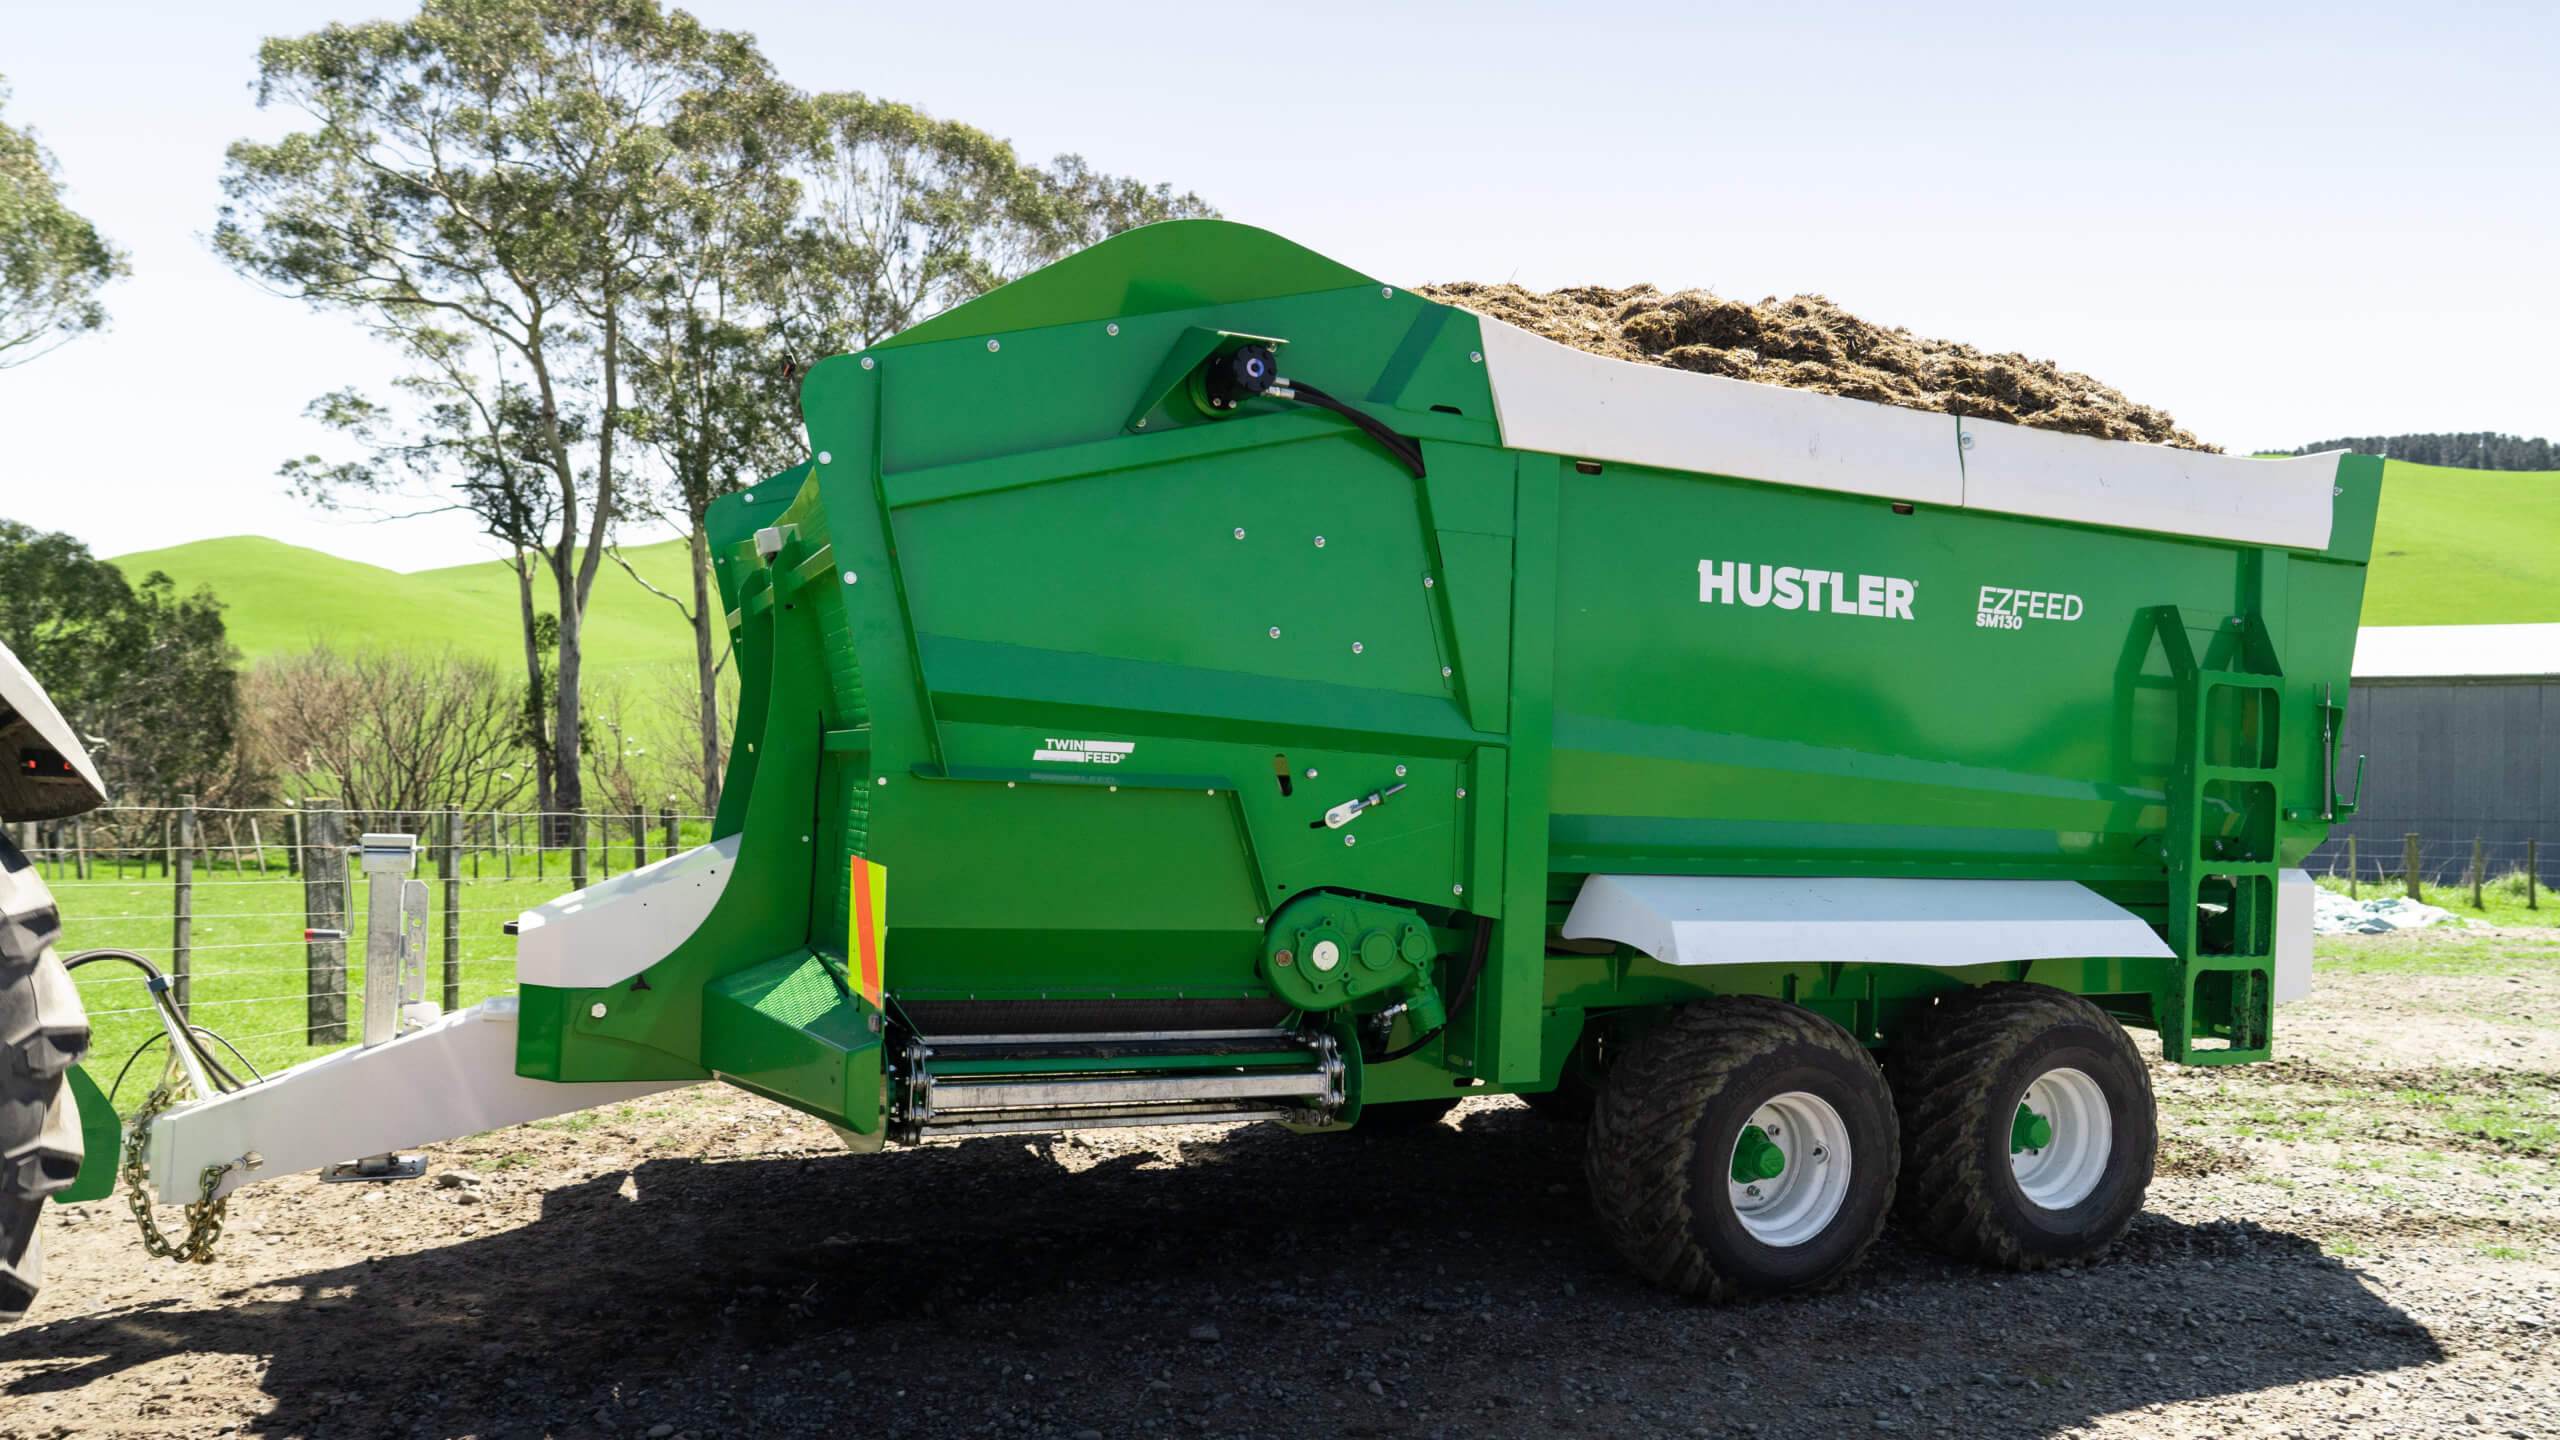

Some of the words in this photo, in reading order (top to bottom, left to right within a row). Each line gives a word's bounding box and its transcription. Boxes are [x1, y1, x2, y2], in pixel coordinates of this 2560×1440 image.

[1698, 559, 1915, 620] HUSTLER
[1977, 585, 2084, 622] EZFEED
[1975, 613, 2023, 630] SM130
[1045, 738, 1084, 751] TWIN
[1085, 752, 1120, 764] FEED
